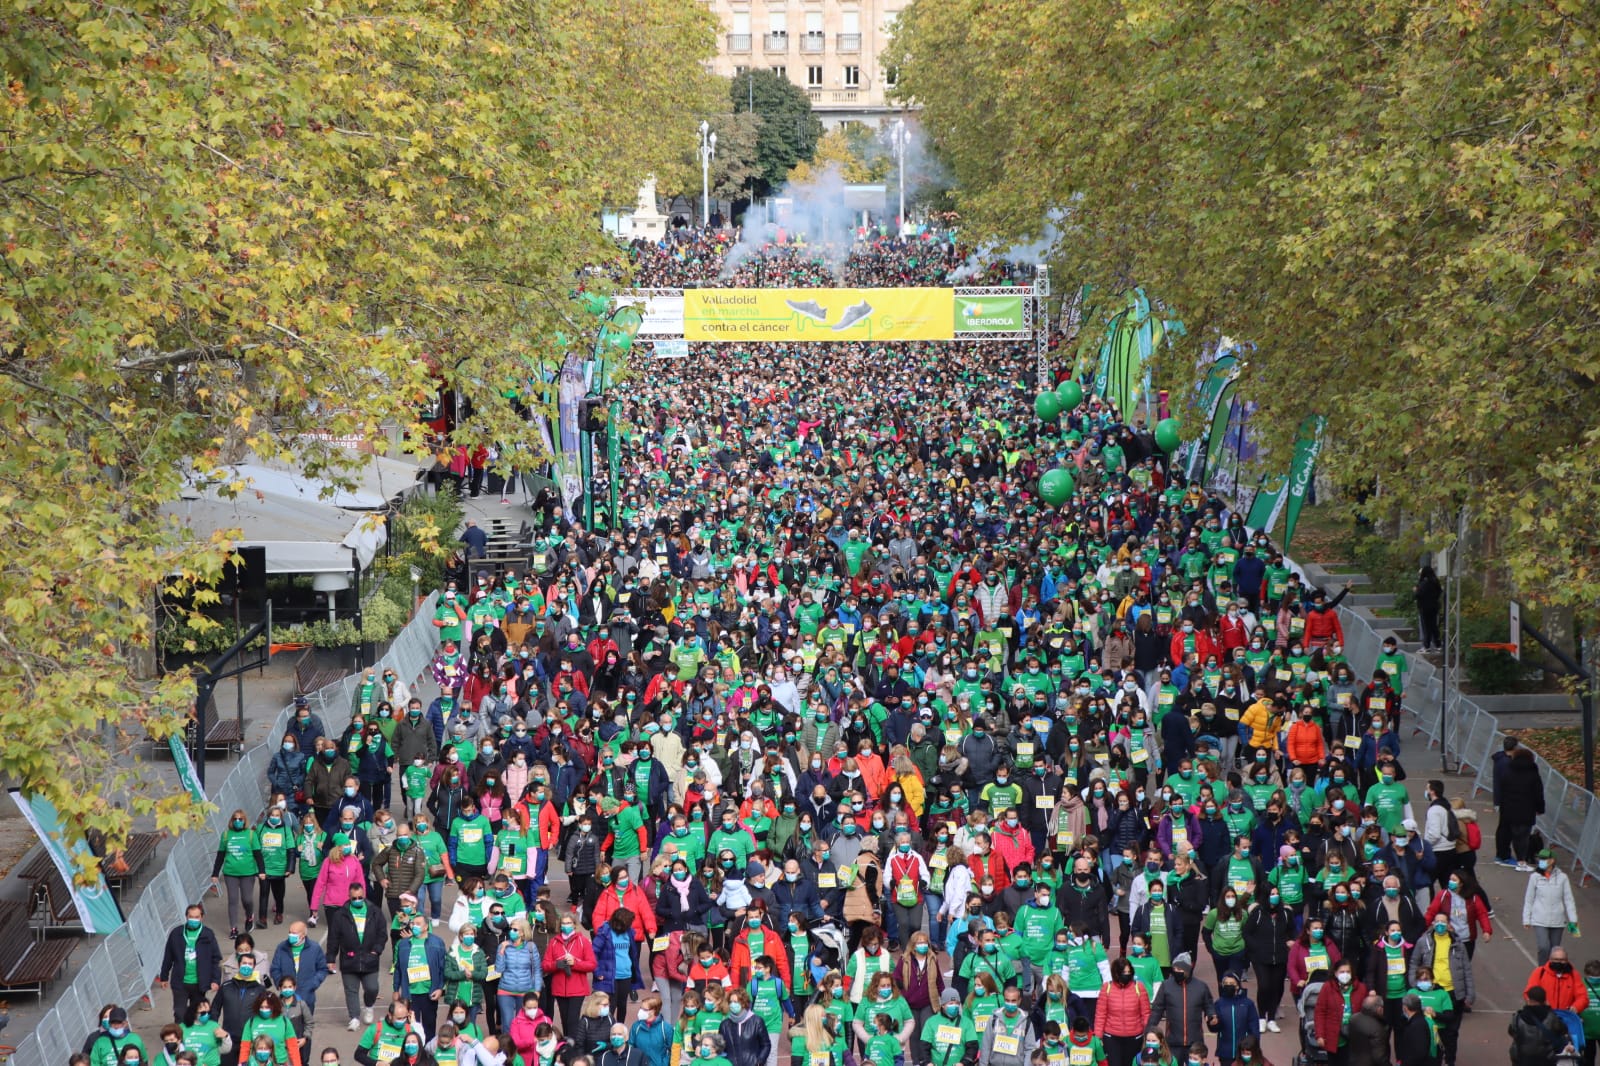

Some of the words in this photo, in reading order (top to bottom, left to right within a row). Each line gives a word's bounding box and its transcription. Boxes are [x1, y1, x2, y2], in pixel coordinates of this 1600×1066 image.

[702, 294, 757, 305] Valladolid
[702, 308, 716, 316] en
[718, 306, 760, 316] marcha
[702, 322, 737, 332] contra
[739, 322, 750, 332] el
[752, 322, 790, 332] cáncer
[967, 318, 1014, 326] IBERDROLA
[1291, 483, 1305, 497] El
